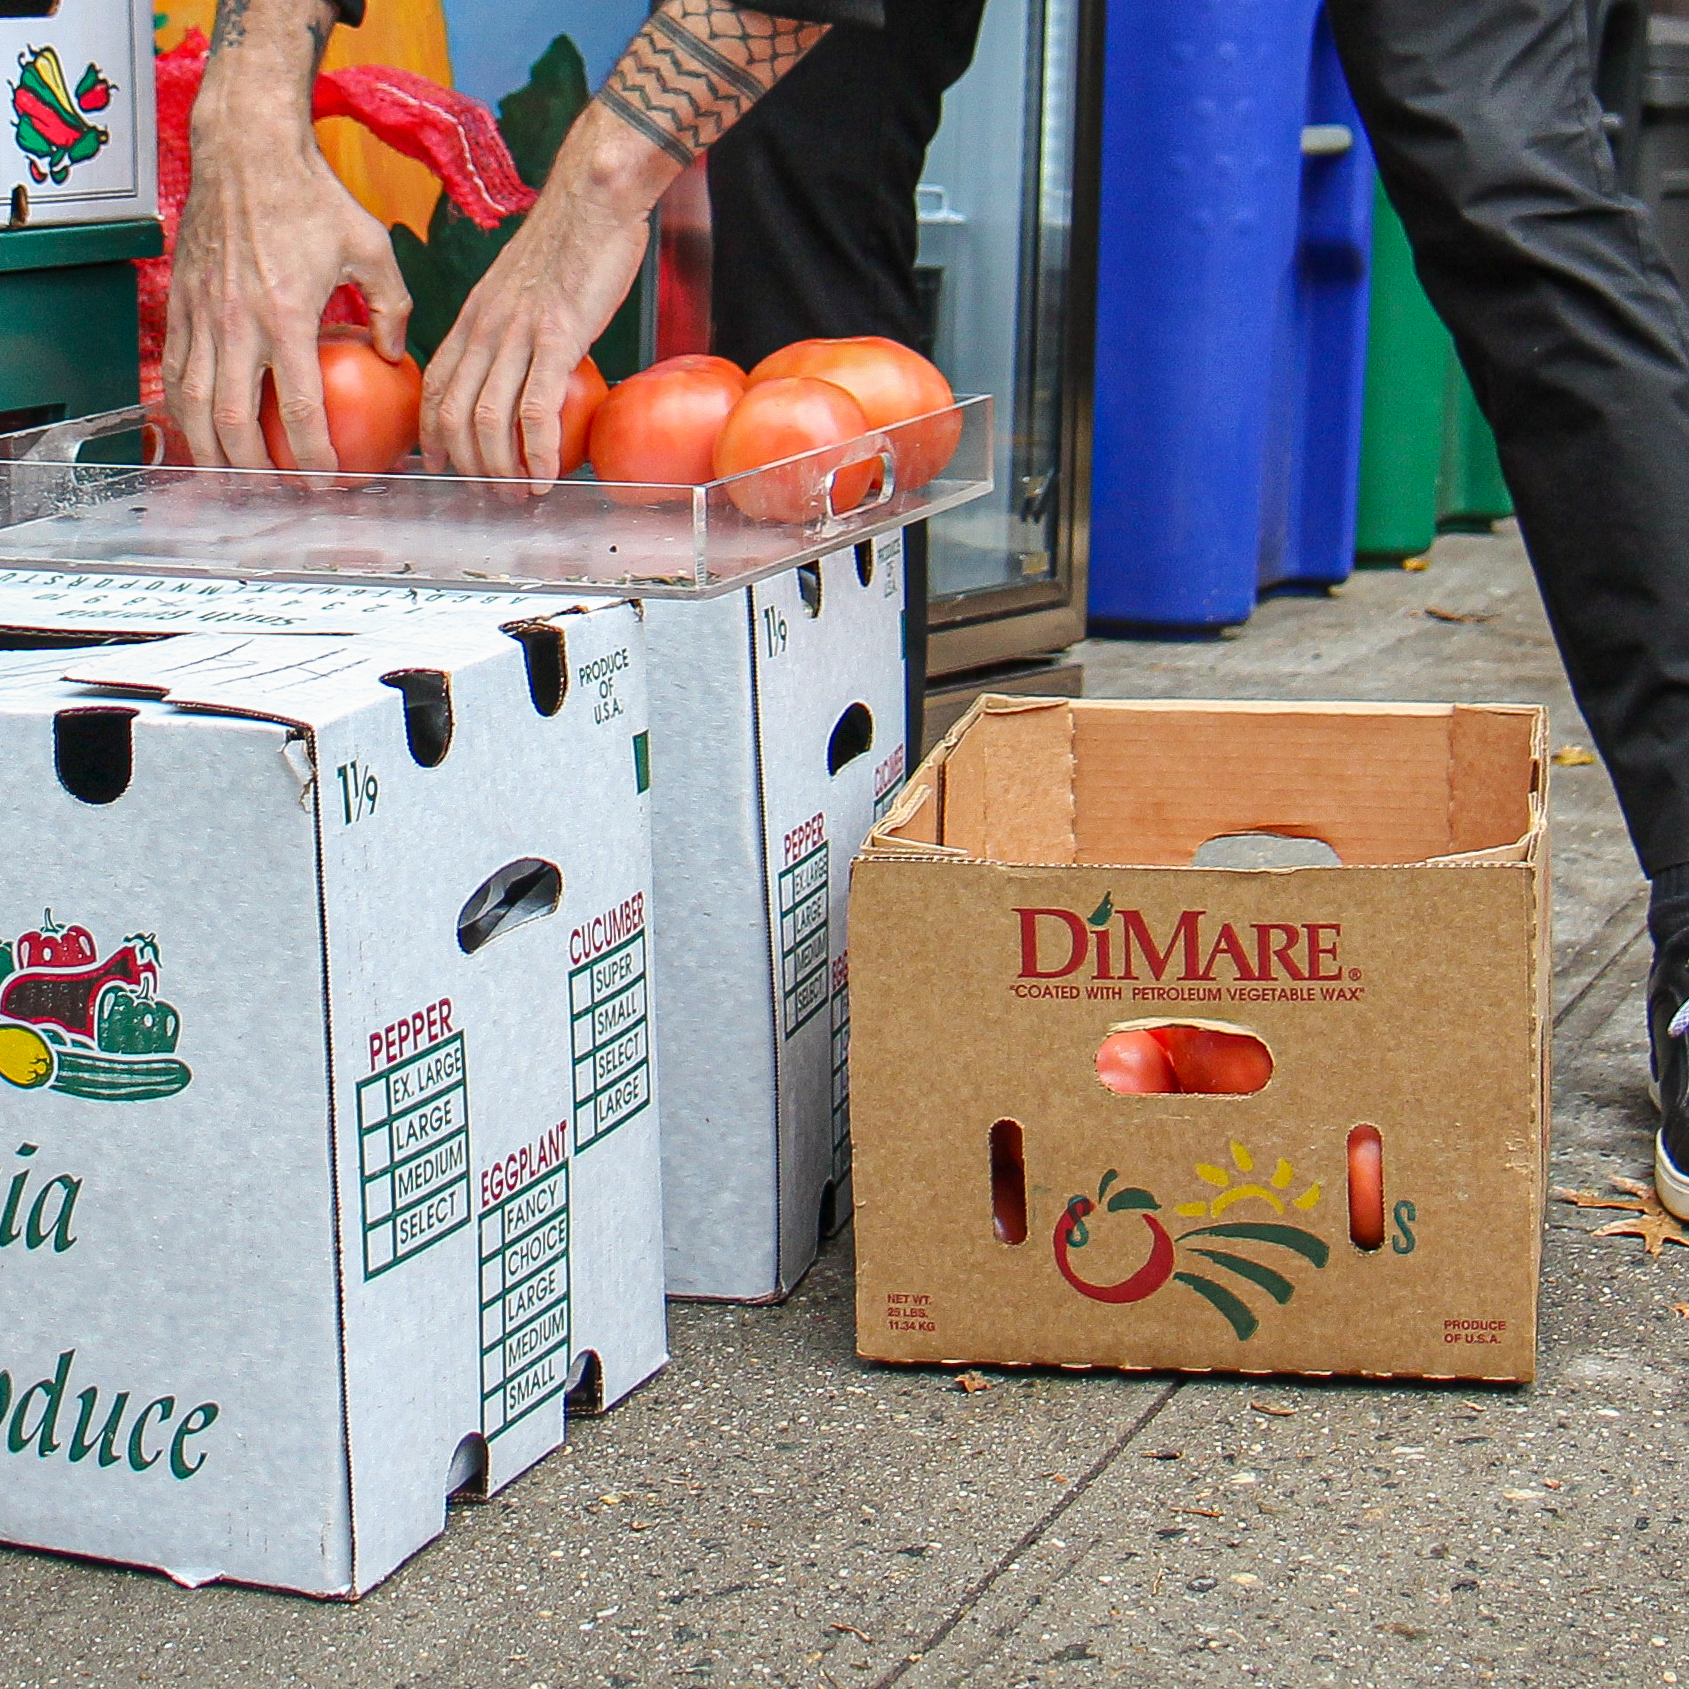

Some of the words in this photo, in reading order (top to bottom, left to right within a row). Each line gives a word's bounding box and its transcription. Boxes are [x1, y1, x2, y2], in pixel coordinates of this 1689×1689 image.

[579, 648, 629, 688] PRODUCE
[599, 680, 615, 699] OF
[594, 698, 624, 725] U.S.A.
[783, 811, 826, 867] PEPPER
[569, 891, 645, 965] CUCUMBER
[595, 952, 633, 993] SUPER
[1086, 987, 1123, 1000] WITH
[1132, 987, 1222, 1001] PETROLEUM
[1226, 987, 1315, 1001] VEGETABLE
[368, 996, 453, 1072] PEPPER
[596, 993, 640, 1036] SMALL
[392, 1075, 415, 1107] EX.
[418, 1046, 463, 1097] LARGE
[598, 1031, 641, 1080] SELECT
[598, 1074, 640, 1121] LARGE
[394, 1098, 453, 1152] LARGE
[397, 1139, 464, 1199] MEDIUM
[480, 1120, 568, 1208] EGGPLANT
[398, 1191, 458, 1246] SELECT
[505, 1178, 558, 1234] FANCY
[1393, 1200, 1417, 1254] S
[507, 1218, 567, 1278] CHOICE
[507, 1274, 557, 1324] LARGE
[888, 1294, 910, 1304] NET
[913, 1294, 932, 1305] WT.
[903, 1307, 928, 1318] LBS.
[507, 1307, 565, 1368] MEDIUM
[918, 1321, 935, 1331] KG
[1444, 1320, 1507, 1331] PRODUCE
[1444, 1333, 1462, 1344] OF
[1465, 1333, 1502, 1344] U.S.A.
[508, 1366, 556, 1411] SMALL
